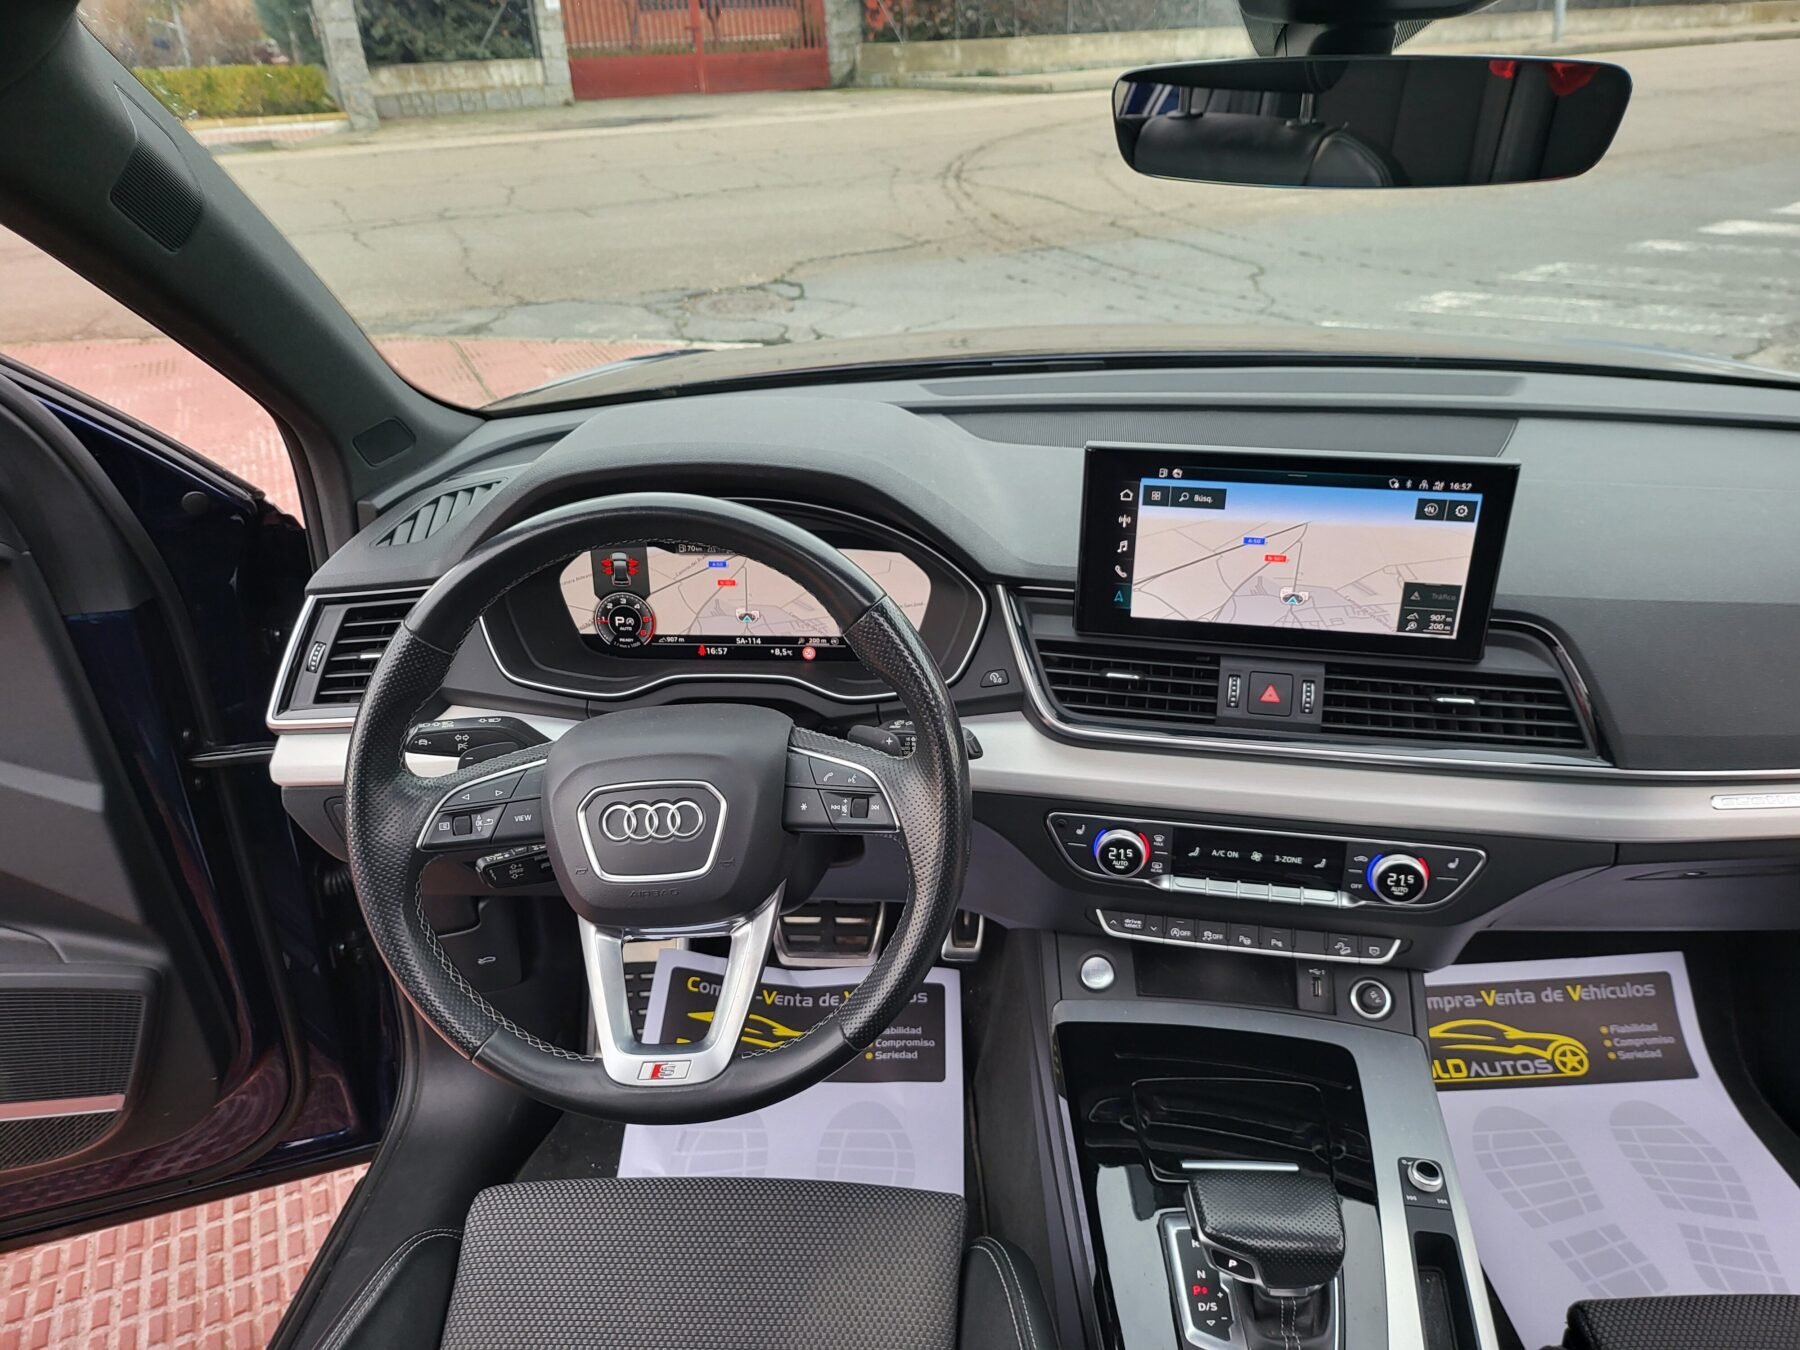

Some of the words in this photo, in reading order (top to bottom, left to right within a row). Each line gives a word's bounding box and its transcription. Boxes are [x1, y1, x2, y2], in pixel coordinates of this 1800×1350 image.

[1450, 482, 1472, 491] 16:57
[615, 616, 625, 627] P
[1429, 614, 1446, 622] 907
[736, 637, 762, 645] SA-114
[706, 647, 728, 655] 16:57
[514, 814, 532, 822] VIEW
[1227, 850, 1239, 858] ON
[1274, 854, 1303, 865] 3-ZONE
[1390, 886, 1409, 894] AUTO
[1541, 986, 1564, 1002] de
[818, 992, 840, 1006] de
[875, 1038, 935, 1048] Compromiso
[875, 1050, 918, 1060] Seriedad
[1228, 1259, 1238, 1268] P
[1196, 1270, 1206, 1279] N
[1198, 1302, 1218, 1312] D/S
